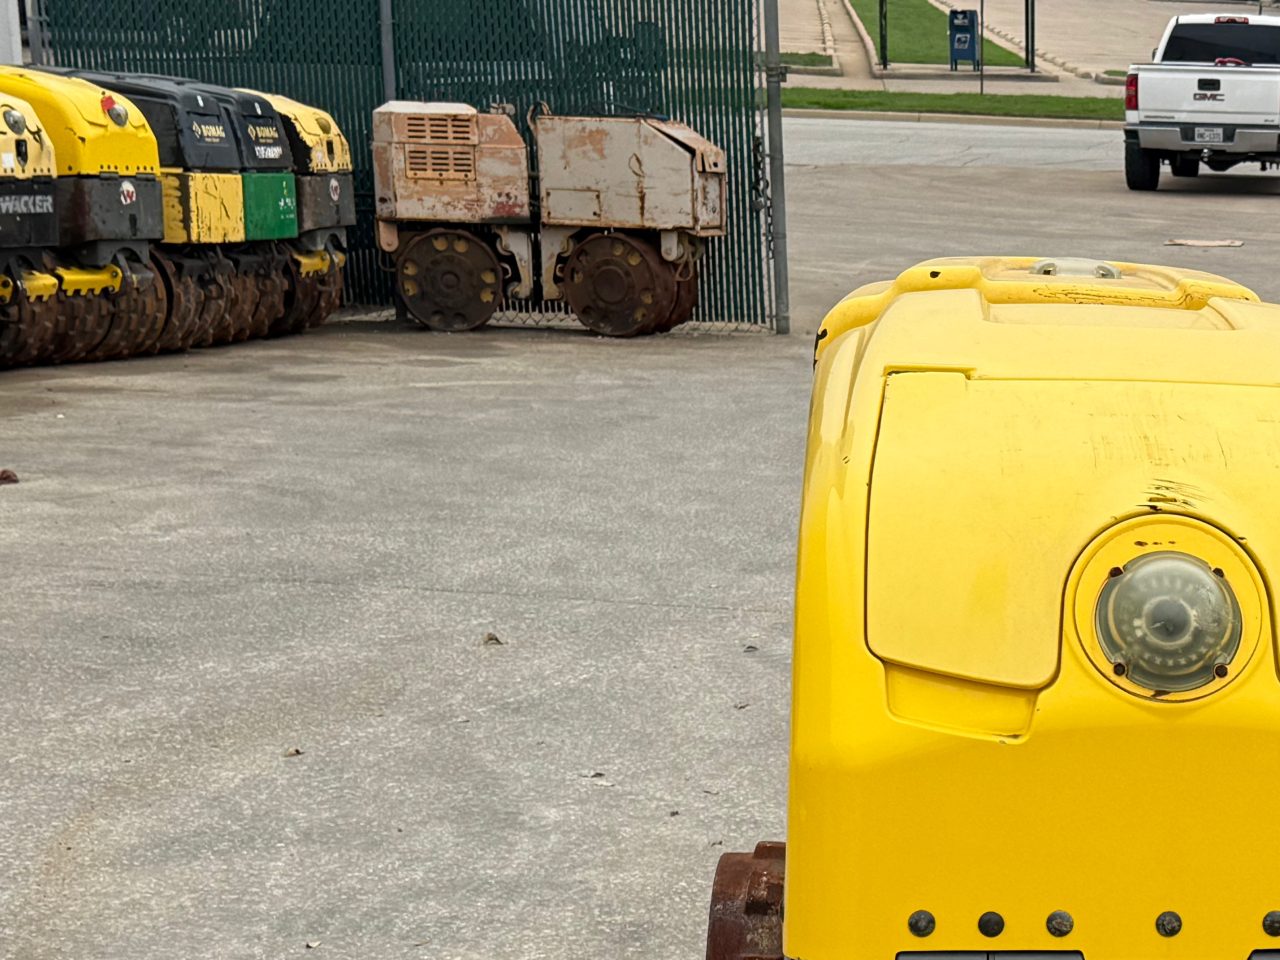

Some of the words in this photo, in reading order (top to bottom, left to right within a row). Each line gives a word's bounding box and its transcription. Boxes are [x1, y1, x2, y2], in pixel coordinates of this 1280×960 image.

[1193, 93, 1225, 101] GMC
[201, 125, 226, 138] BOMAG
[255, 126, 279, 138] BOMAG
[0, 194, 54, 213] WACKER
